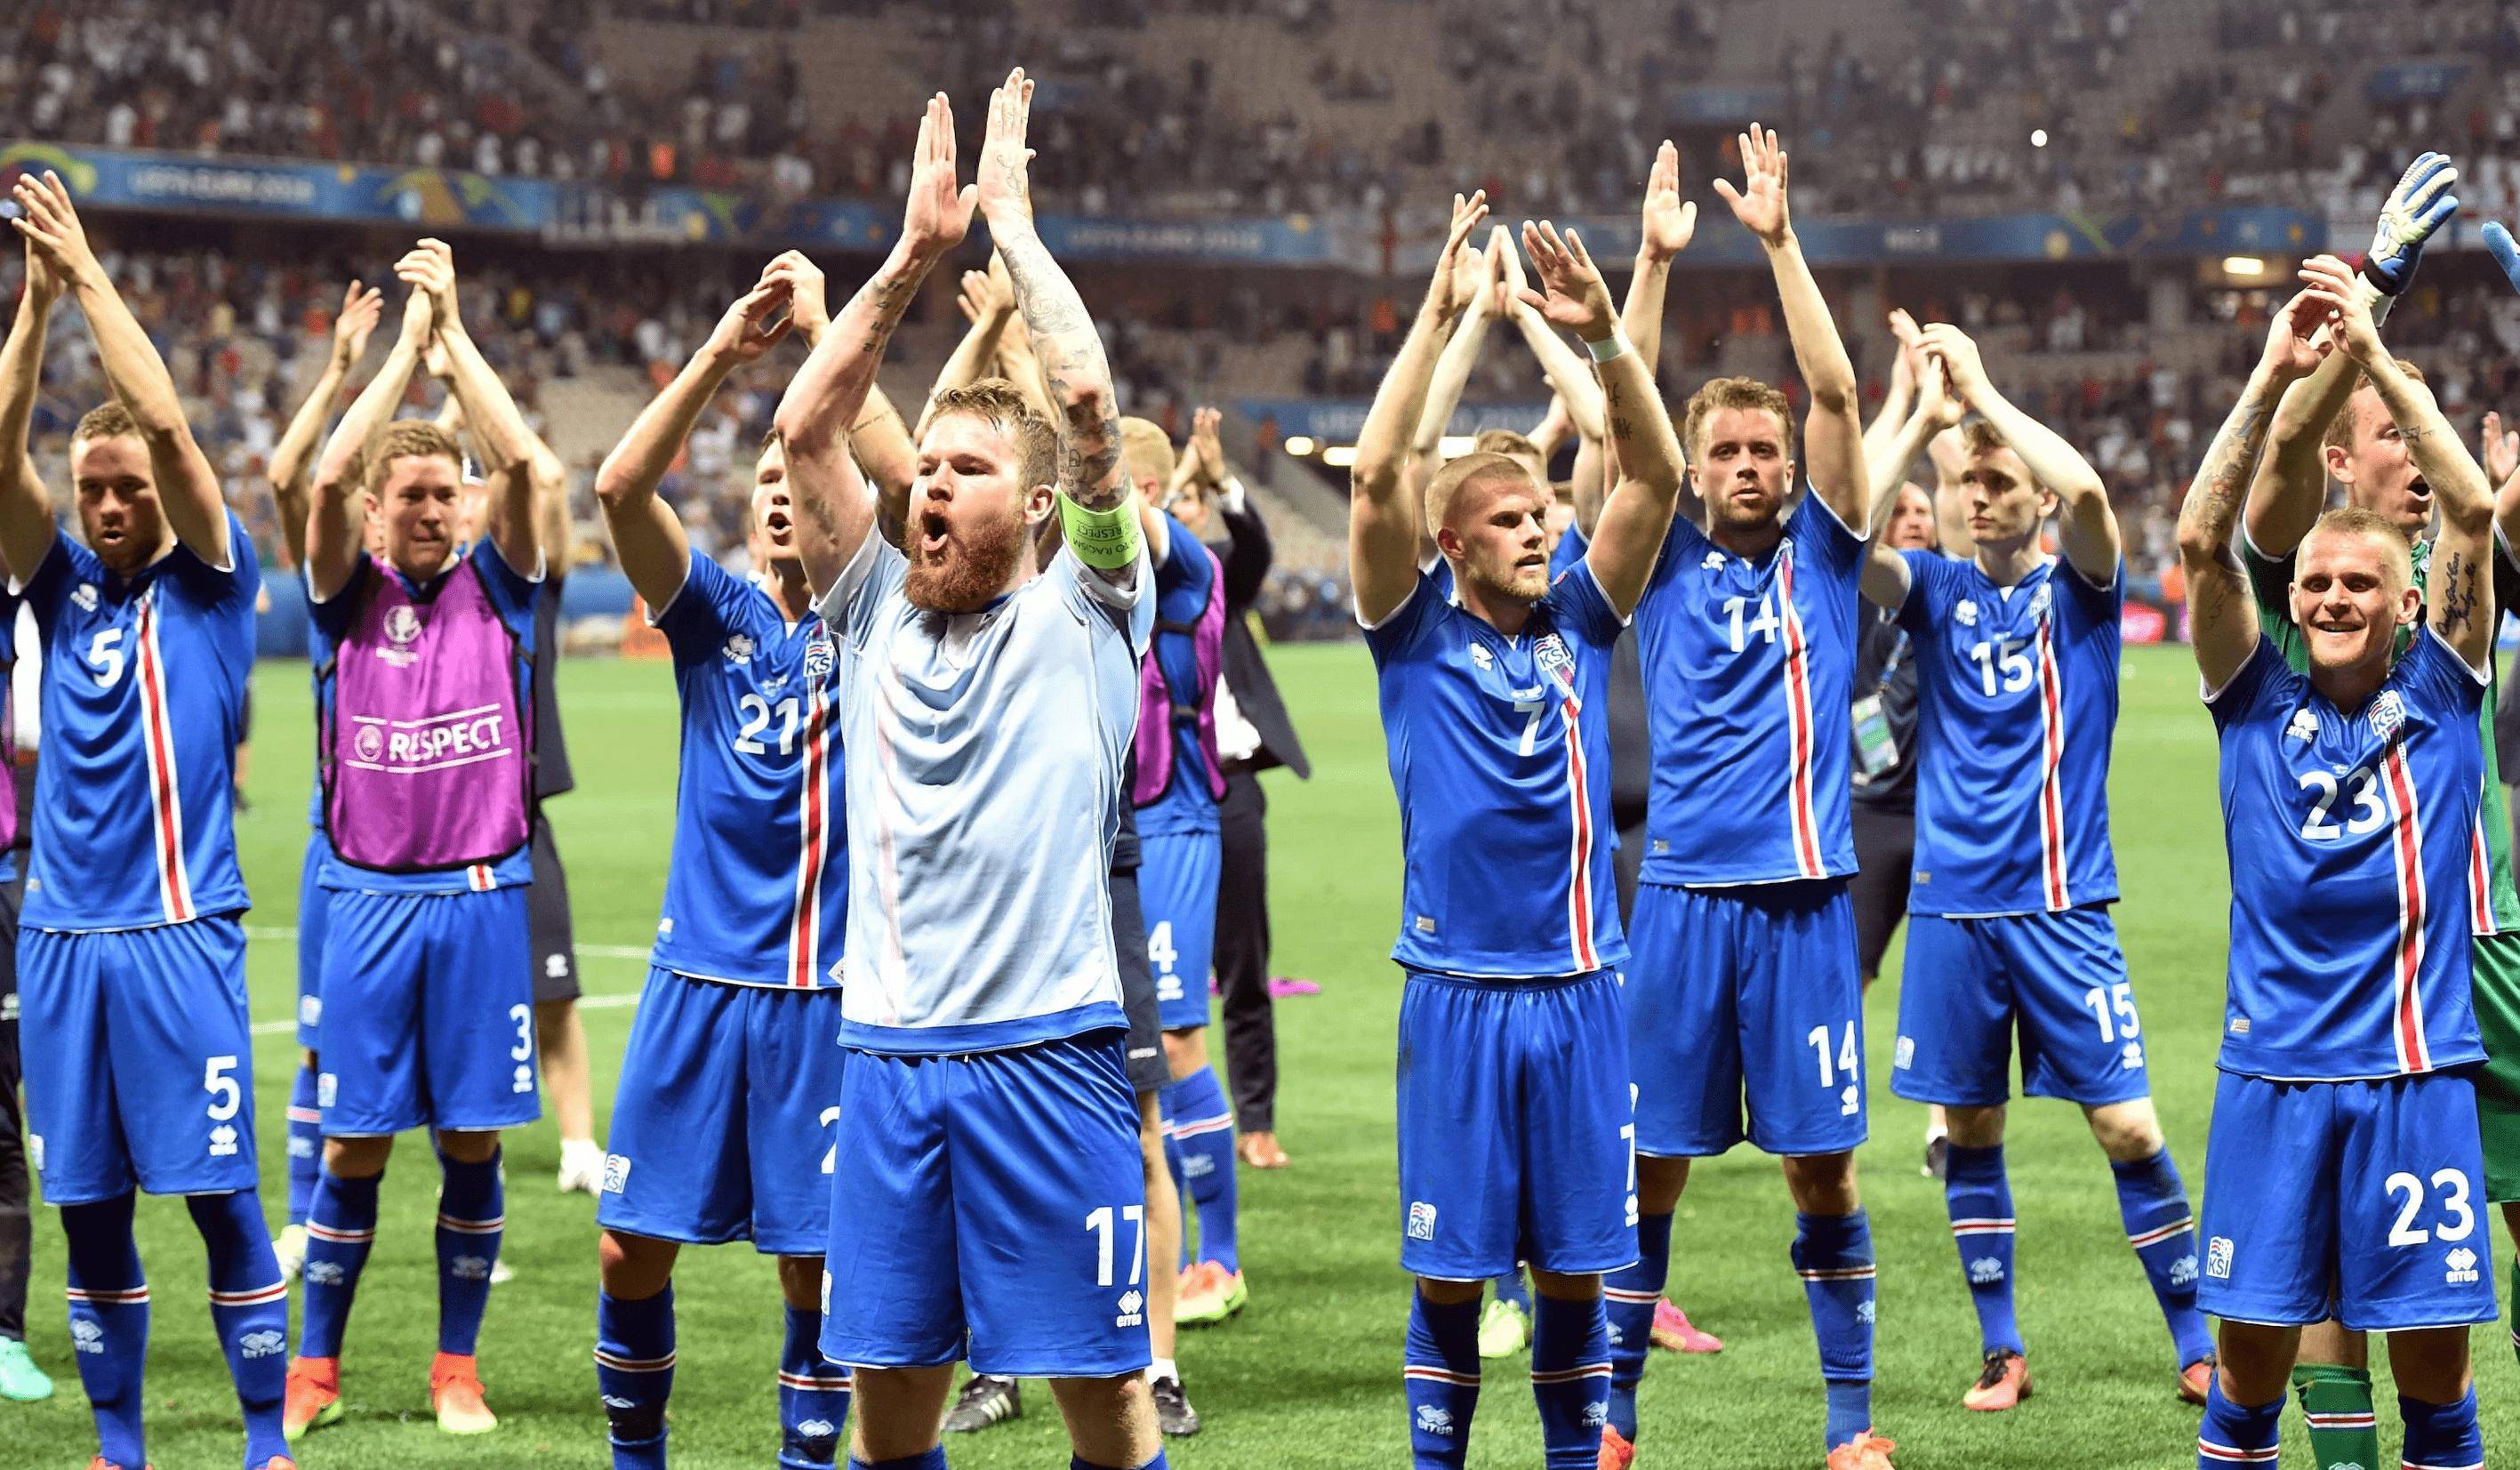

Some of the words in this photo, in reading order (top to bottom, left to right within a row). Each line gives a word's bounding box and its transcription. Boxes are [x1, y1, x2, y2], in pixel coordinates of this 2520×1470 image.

[1722, 593, 1780, 653] 14
[88, 628, 124, 688] 5
[1970, 640, 2034, 697] 15
[389, 715, 503, 762] RESPECT
[734, 693, 799, 756] 21
[1513, 701, 1545, 757] 7
[2299, 766, 2387, 840] 23
[1148, 920, 1178, 973] 4
[510, 1003, 533, 1062] 3
[2085, 982, 2140, 1043] 15
[1809, 1020, 1858, 1088] 14
[205, 1055, 241, 1121] 5
[2385, 1168, 2475, 1247] 23
[1086, 1205, 1144, 1287] 17
